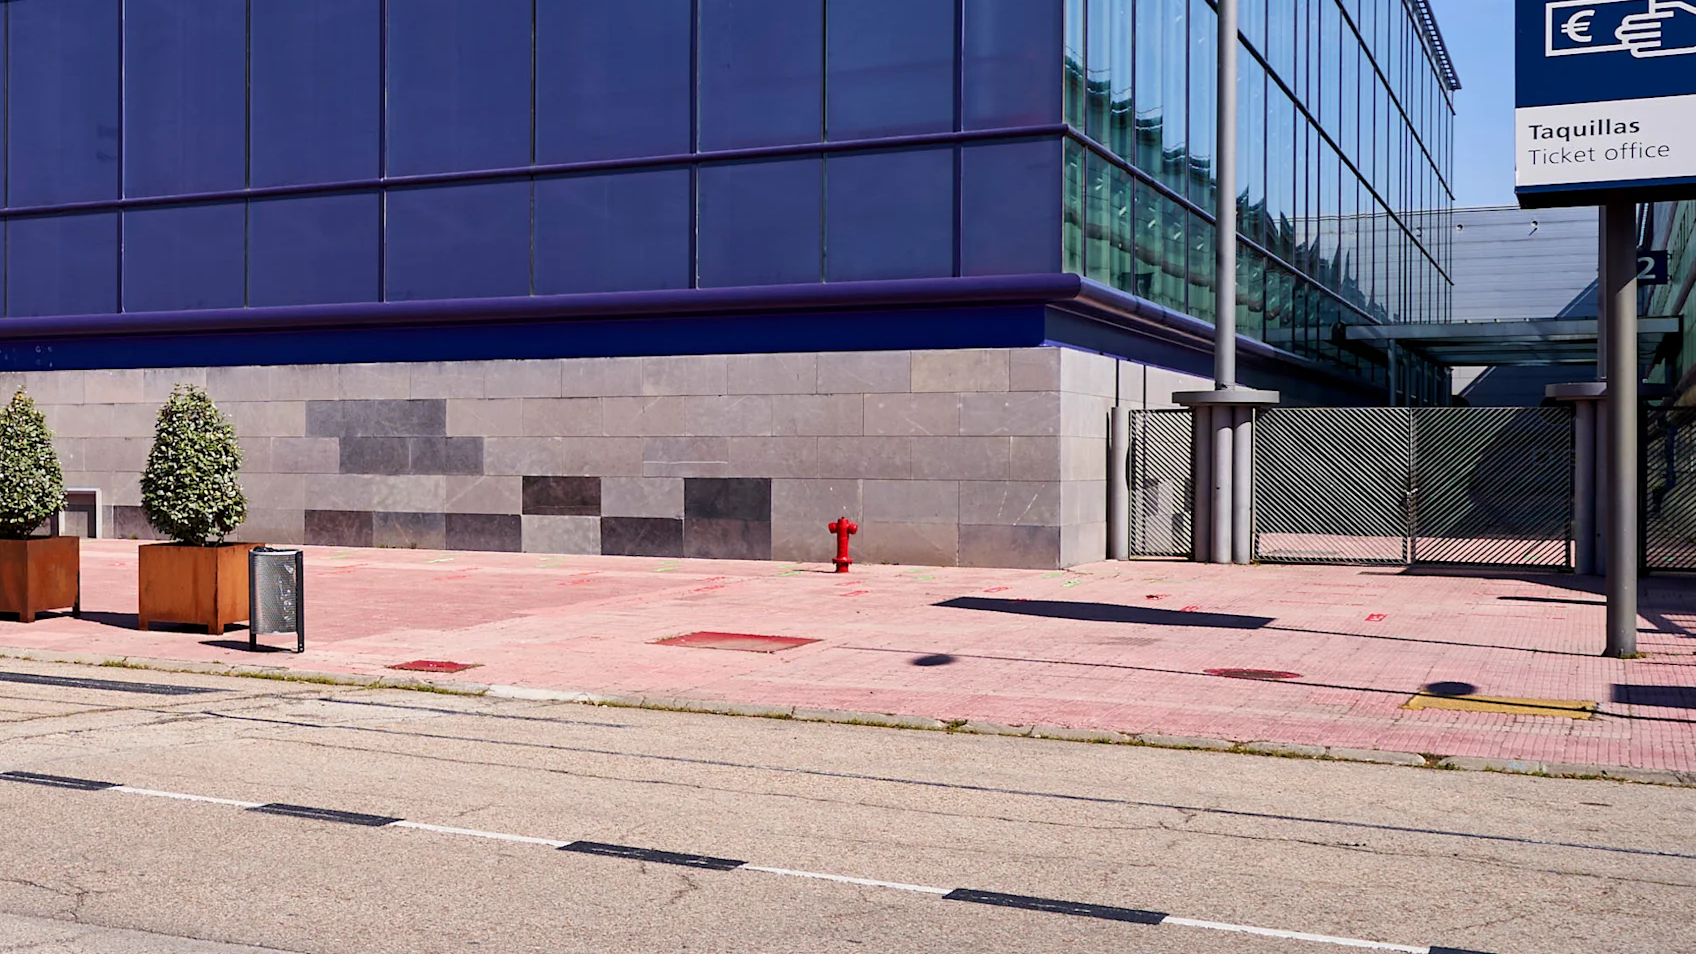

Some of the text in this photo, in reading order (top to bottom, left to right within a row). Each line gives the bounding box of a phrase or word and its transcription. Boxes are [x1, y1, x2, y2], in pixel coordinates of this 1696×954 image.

[1529, 119, 1640, 142] Taquillas
[1528, 142, 1670, 165] Ticket office
[1637, 257, 1656, 279] 2
